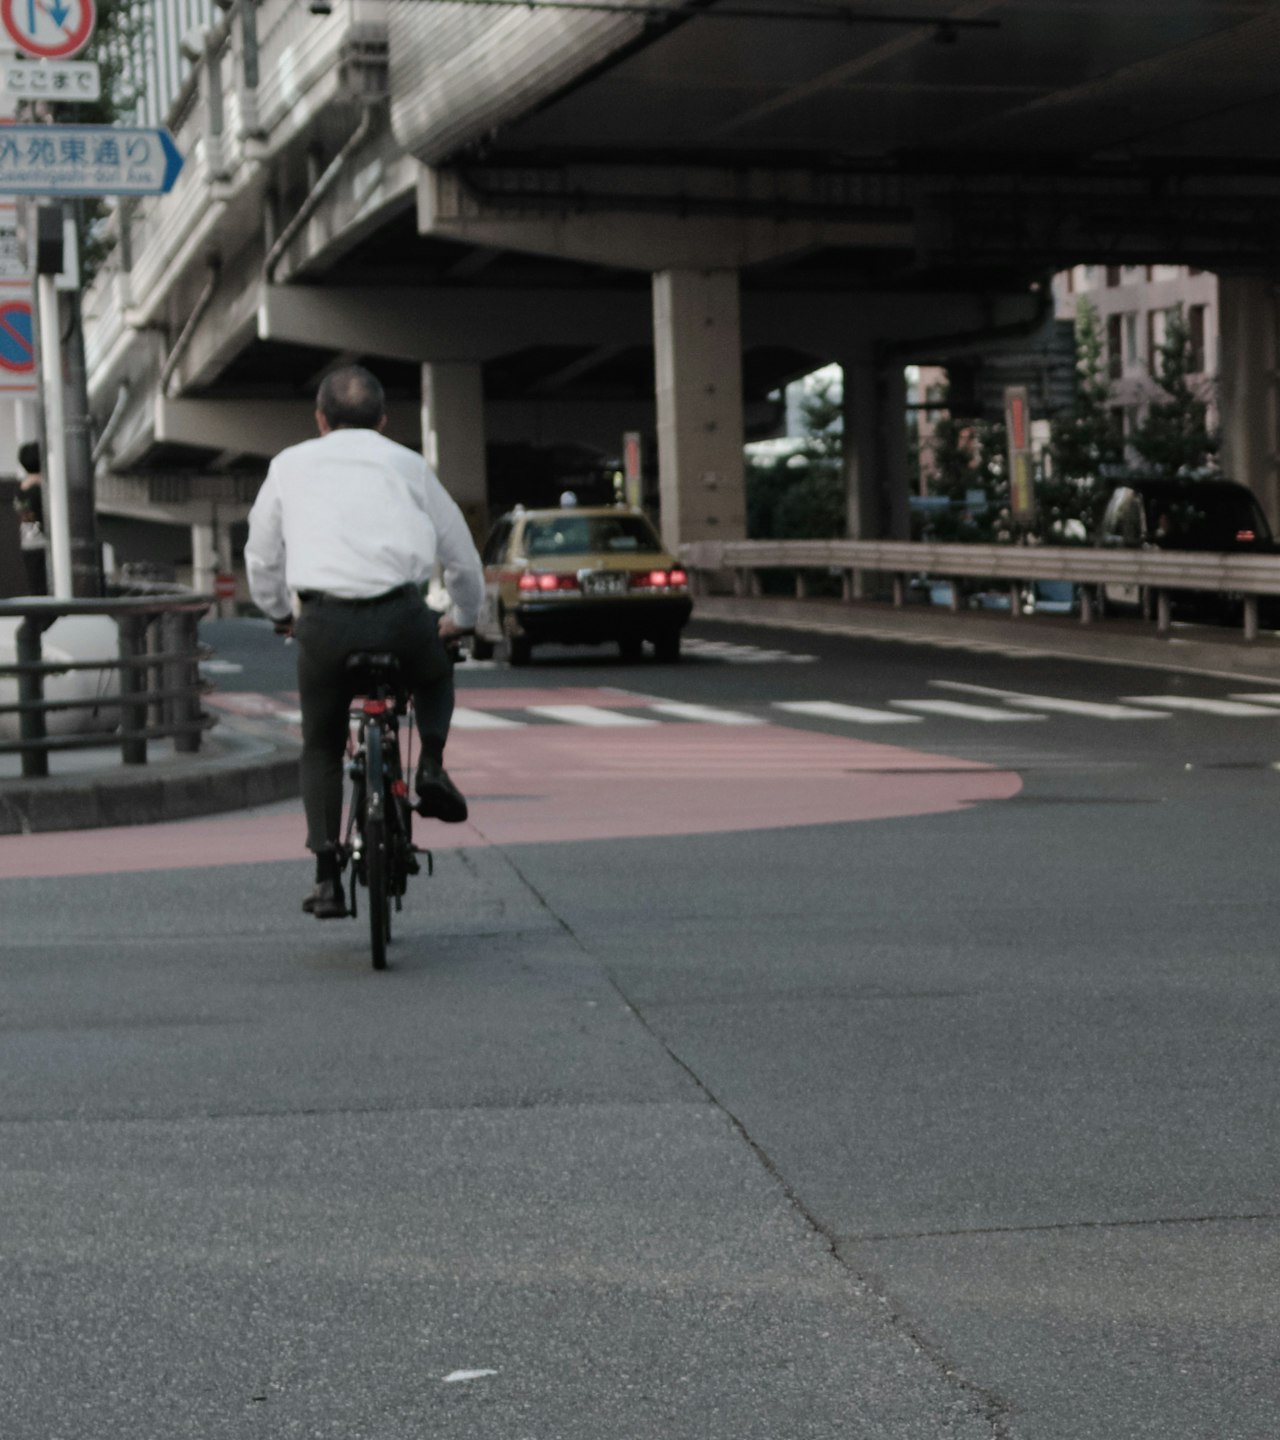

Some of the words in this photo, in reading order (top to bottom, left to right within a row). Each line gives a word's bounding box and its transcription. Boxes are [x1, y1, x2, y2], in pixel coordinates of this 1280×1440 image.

[7, 69, 92, 91] ここまで
[0, 134, 151, 166] 外苑東通り
